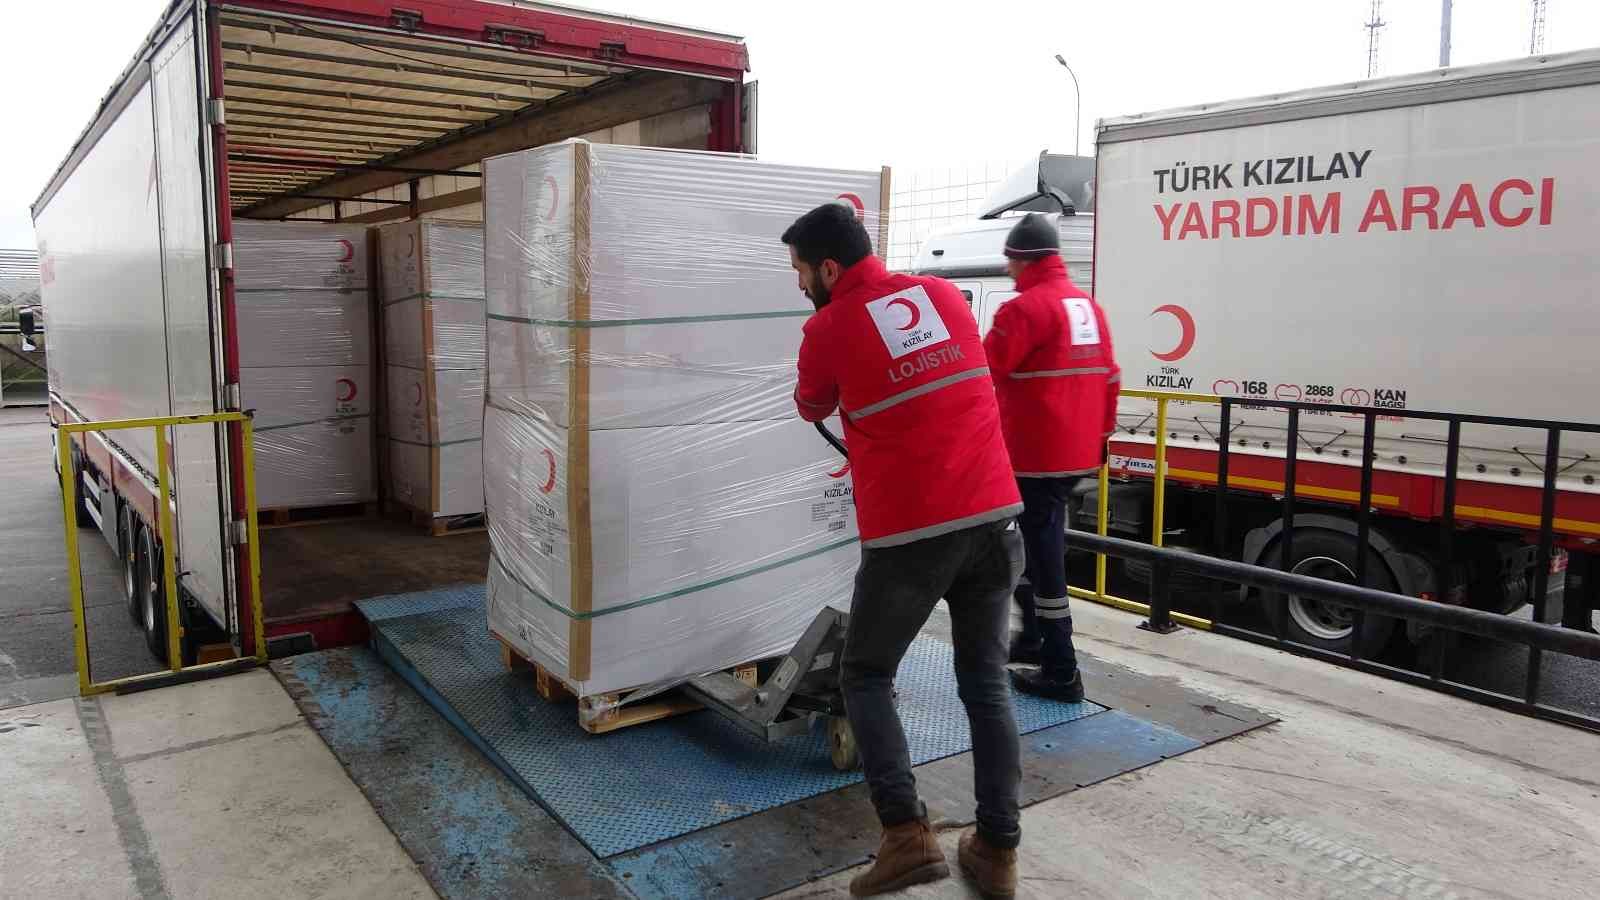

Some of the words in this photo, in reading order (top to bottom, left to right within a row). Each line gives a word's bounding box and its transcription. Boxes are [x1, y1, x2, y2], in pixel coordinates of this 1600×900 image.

[1153, 161, 1233, 194] TÜRK
[1243, 149, 1373, 187] KIZILAY
[1153, 191, 1342, 241] YARDIM
[1358, 177, 1556, 233] ARACI
[902, 331, 934, 349] KIZILAY
[1161, 366, 1180, 375] TÜRK
[1146, 375, 1193, 390] KIZILAY
[1241, 381, 1268, 395] 168
[1305, 384, 1334, 397] 2868
[1374, 389, 1406, 402] KAN
[824, 487, 853, 499] KIZILAY
